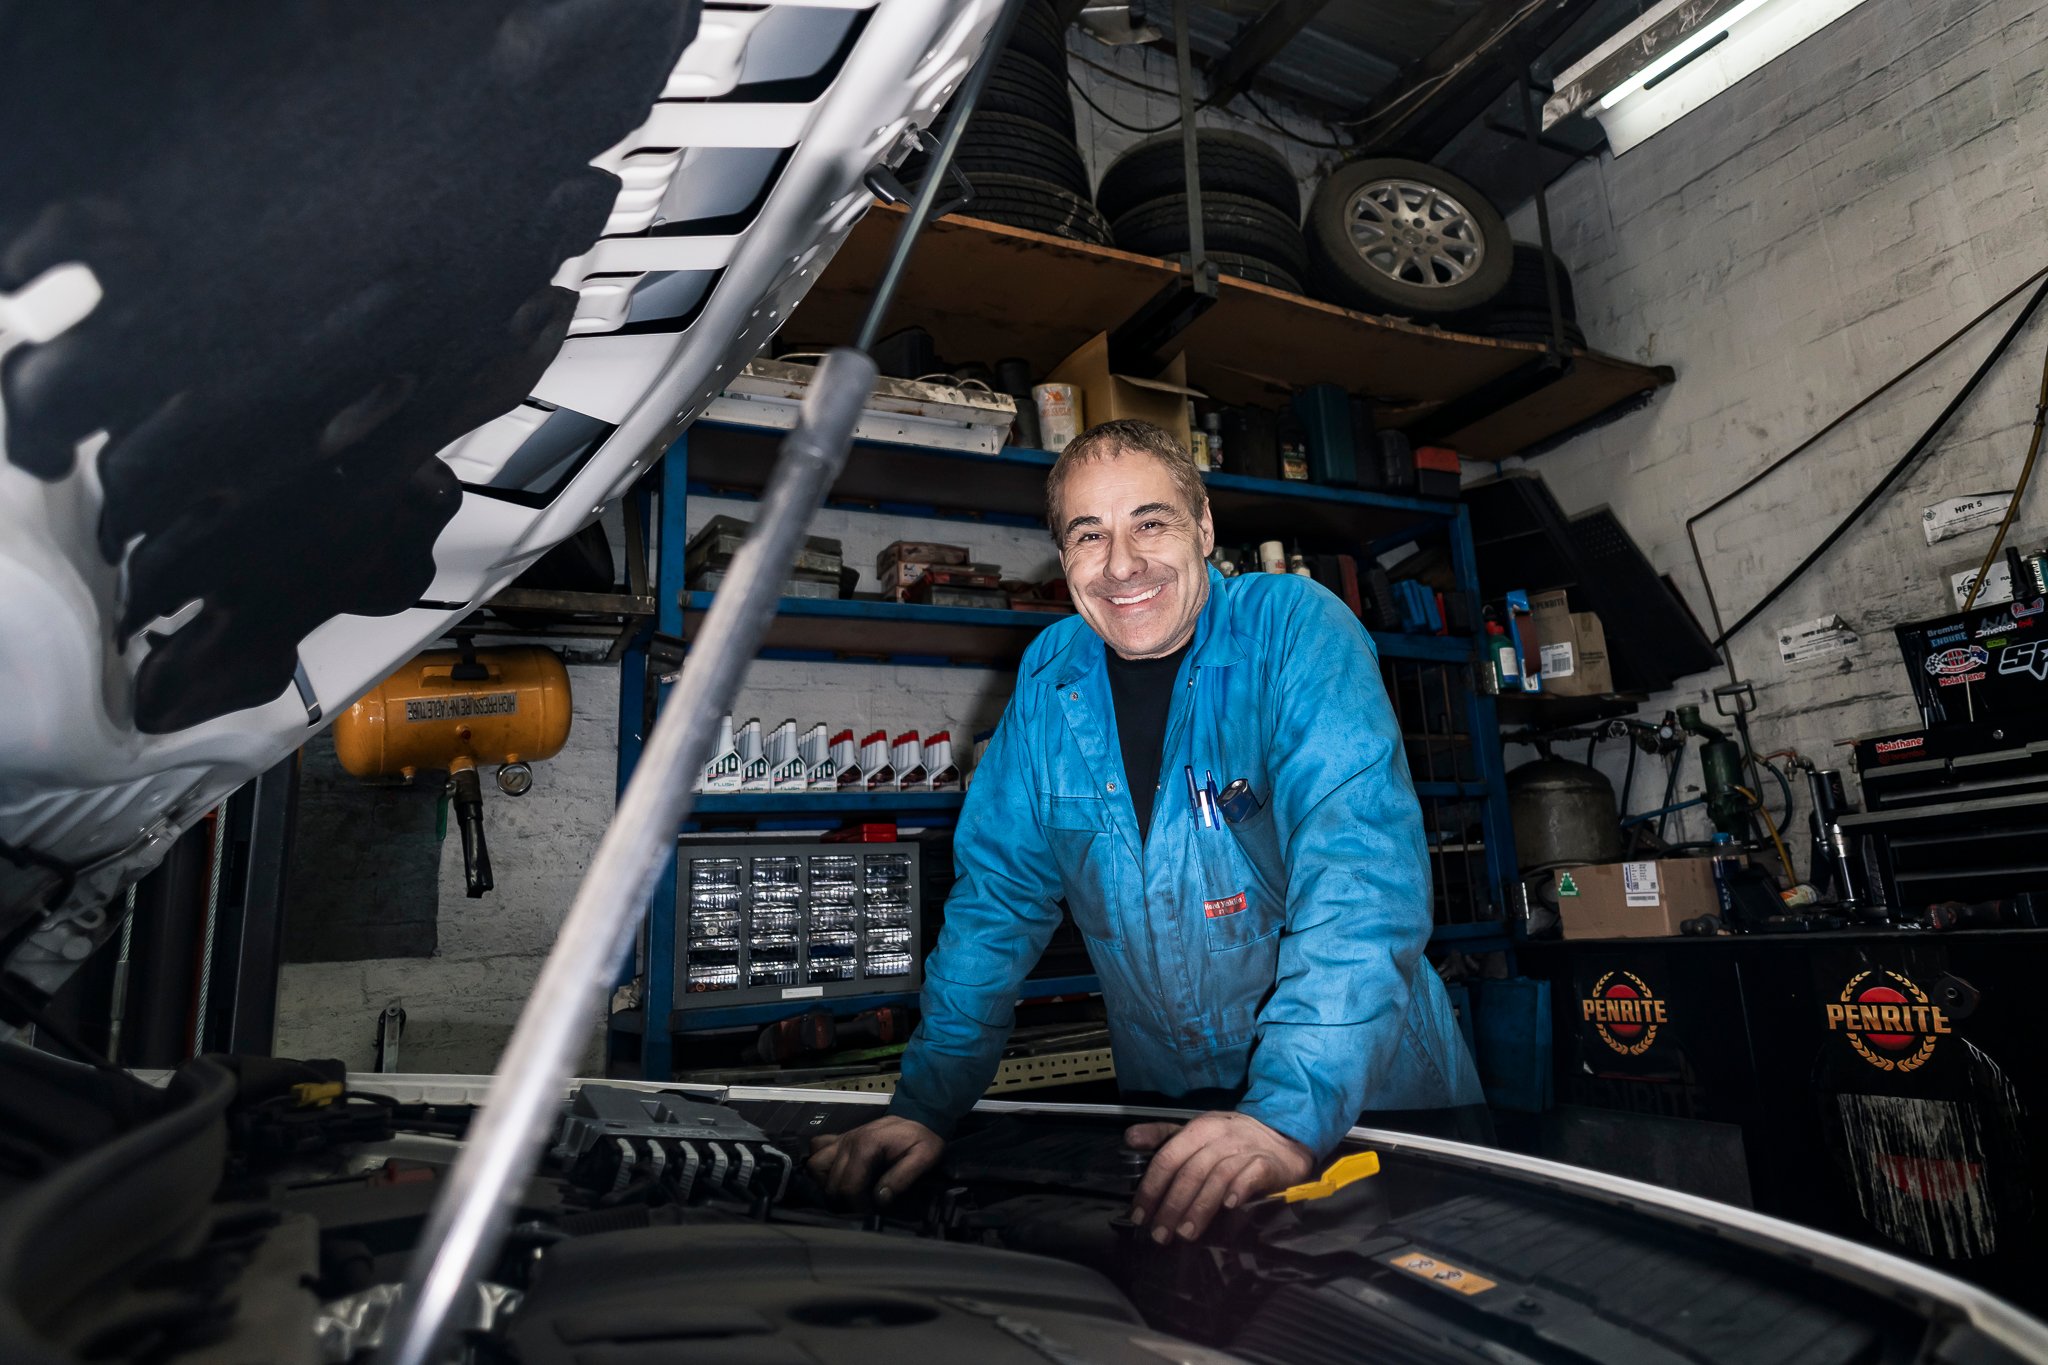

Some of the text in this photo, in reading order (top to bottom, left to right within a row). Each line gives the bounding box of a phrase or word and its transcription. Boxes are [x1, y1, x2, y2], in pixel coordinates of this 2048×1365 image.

[1954, 499, 1983, 514] HPR 5
[1956, 578, 1991, 594] PENTE
[1975, 622, 2018, 639] Drivetech
[1930, 631, 1968, 648] ENDURE
[407, 701, 427, 721] TUBE
[498, 695, 516, 713] HIGH
[1876, 737, 1924, 753] Nolathane
[1583, 999, 1668, 1025] PENRITE
[1826, 1003, 1953, 1034] PENRITE
